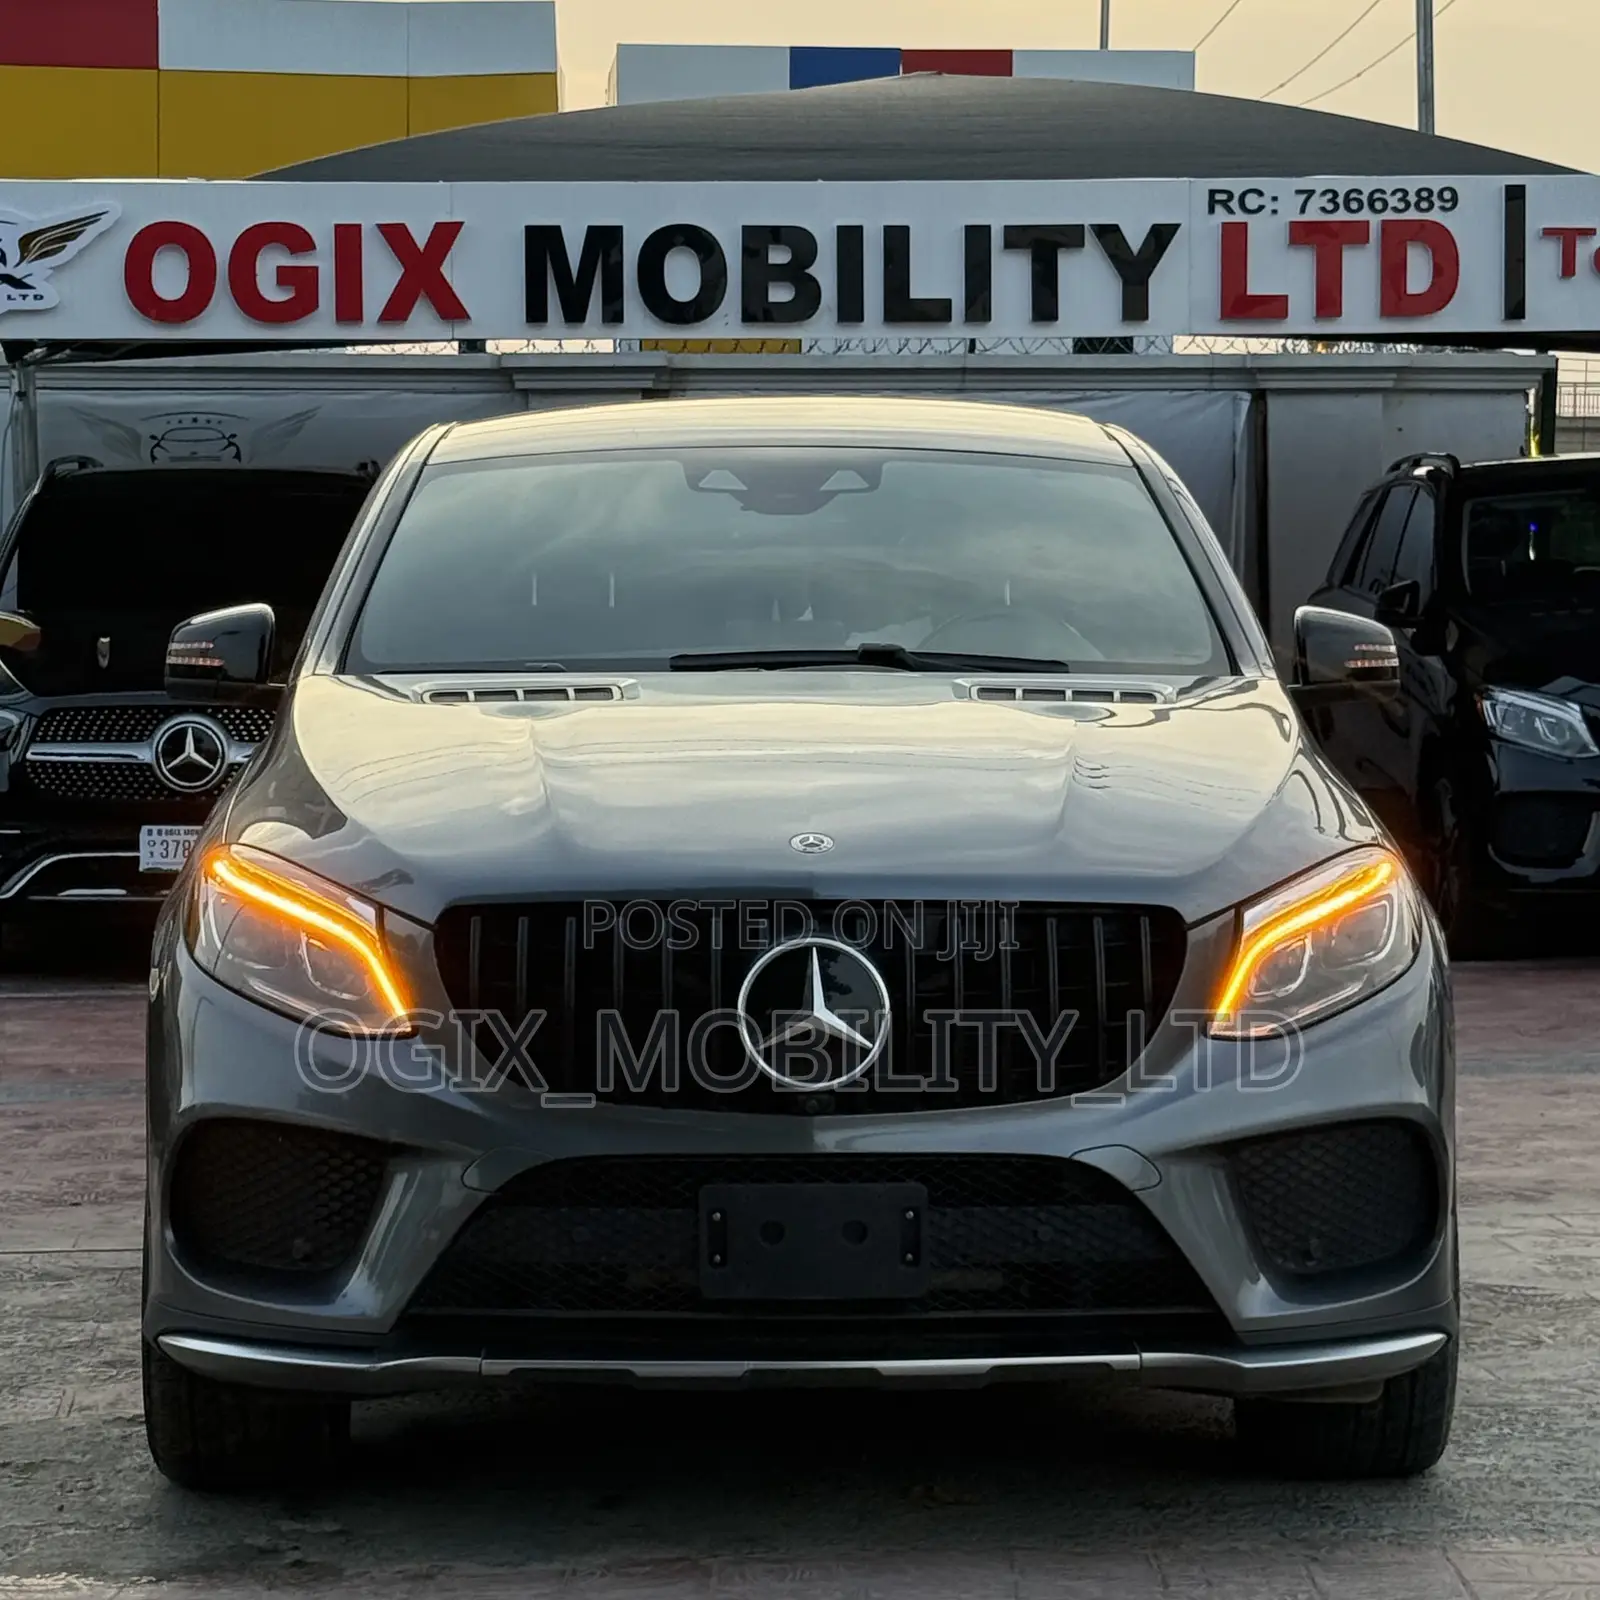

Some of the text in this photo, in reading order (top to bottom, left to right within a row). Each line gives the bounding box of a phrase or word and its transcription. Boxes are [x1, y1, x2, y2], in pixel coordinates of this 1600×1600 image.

[1207, 186, 1459, 215] RC: 7366389
[124, 221, 471, 324] OGIX
[524, 223, 1182, 325] MOBILITY
[1219, 219, 1460, 319] LTD
[1541, 227, 1600, 278] T
[160, 839, 199, 859] 378
